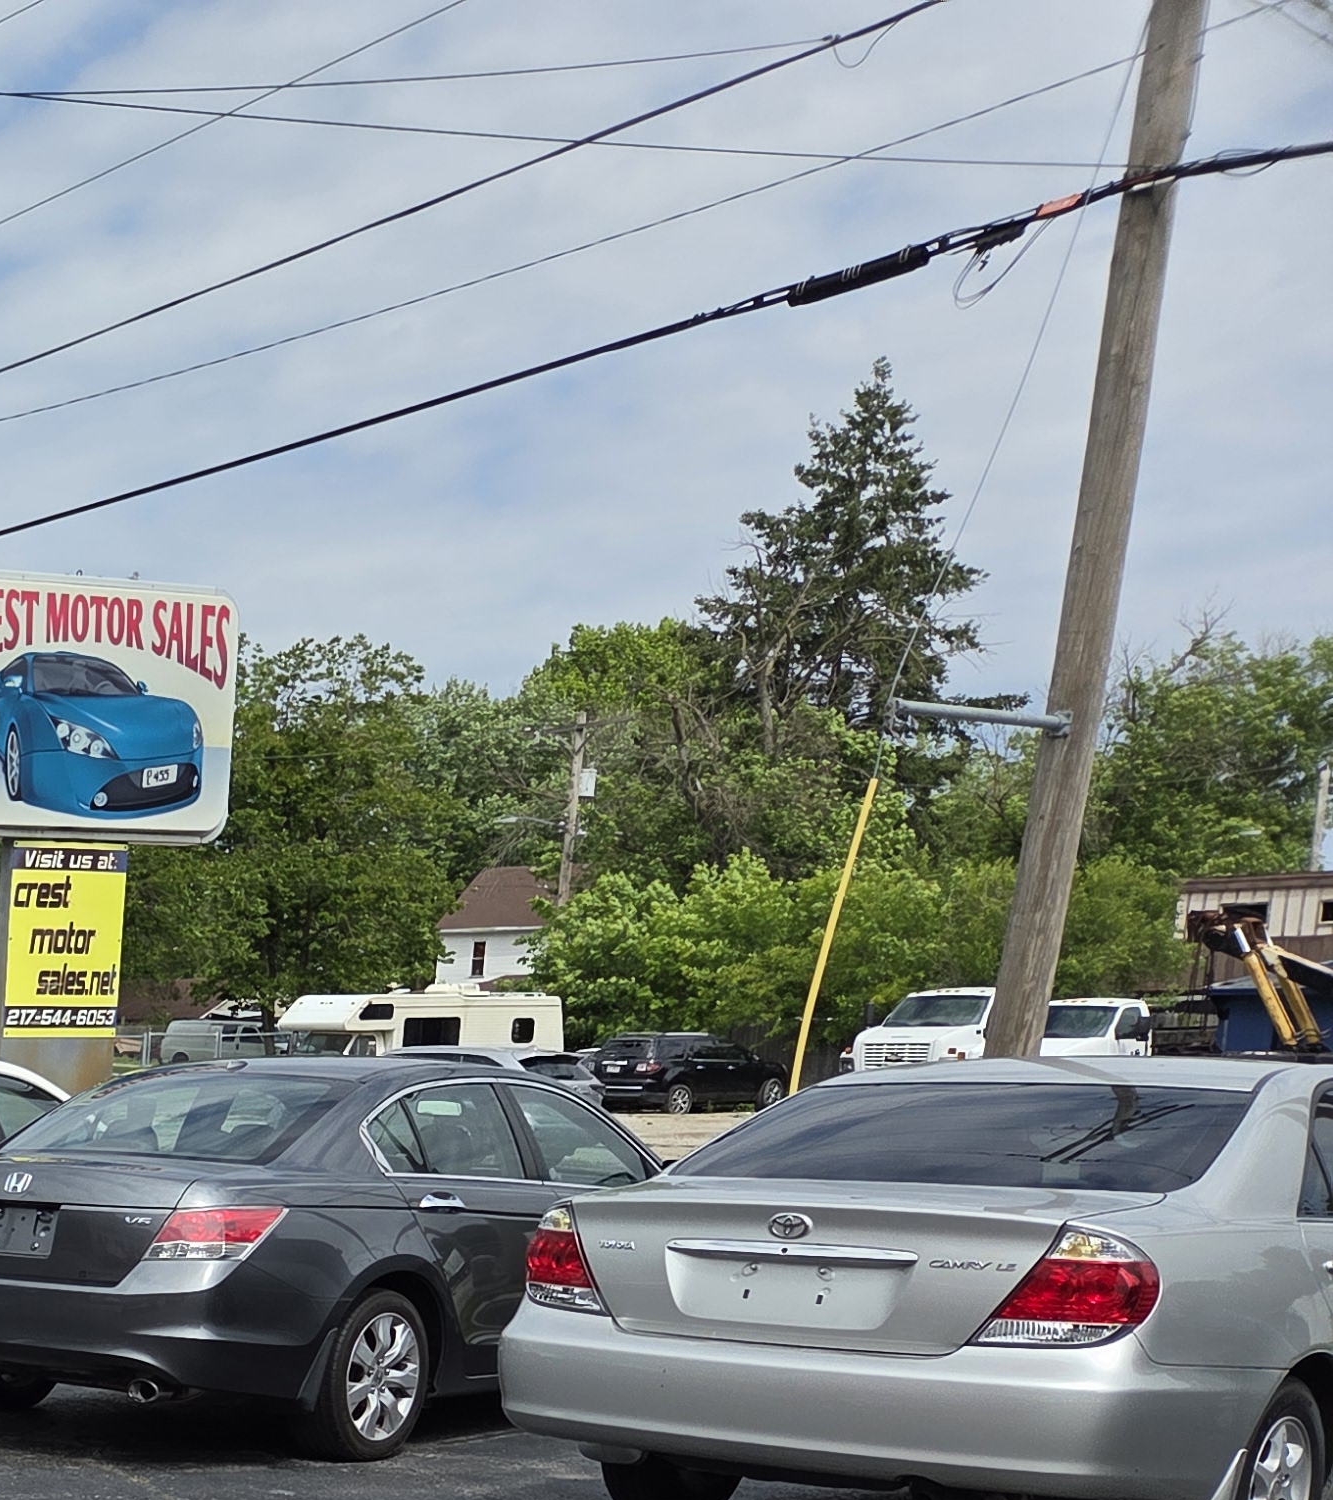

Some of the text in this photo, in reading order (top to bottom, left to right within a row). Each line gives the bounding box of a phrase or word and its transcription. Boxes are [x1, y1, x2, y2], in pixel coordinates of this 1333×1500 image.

[46, 592, 144, 650] MOTOR
[151, 599, 231, 690] SALES
[24, 850, 118, 870] Visit us at:
[14, 875, 72, 908] crest
[29, 921, 96, 954] motor
[36, 963, 116, 996] sales.net
[6, 1008, 116, 1026] 217-544-6053
[929, 1260, 993, 1271] CAMRY
